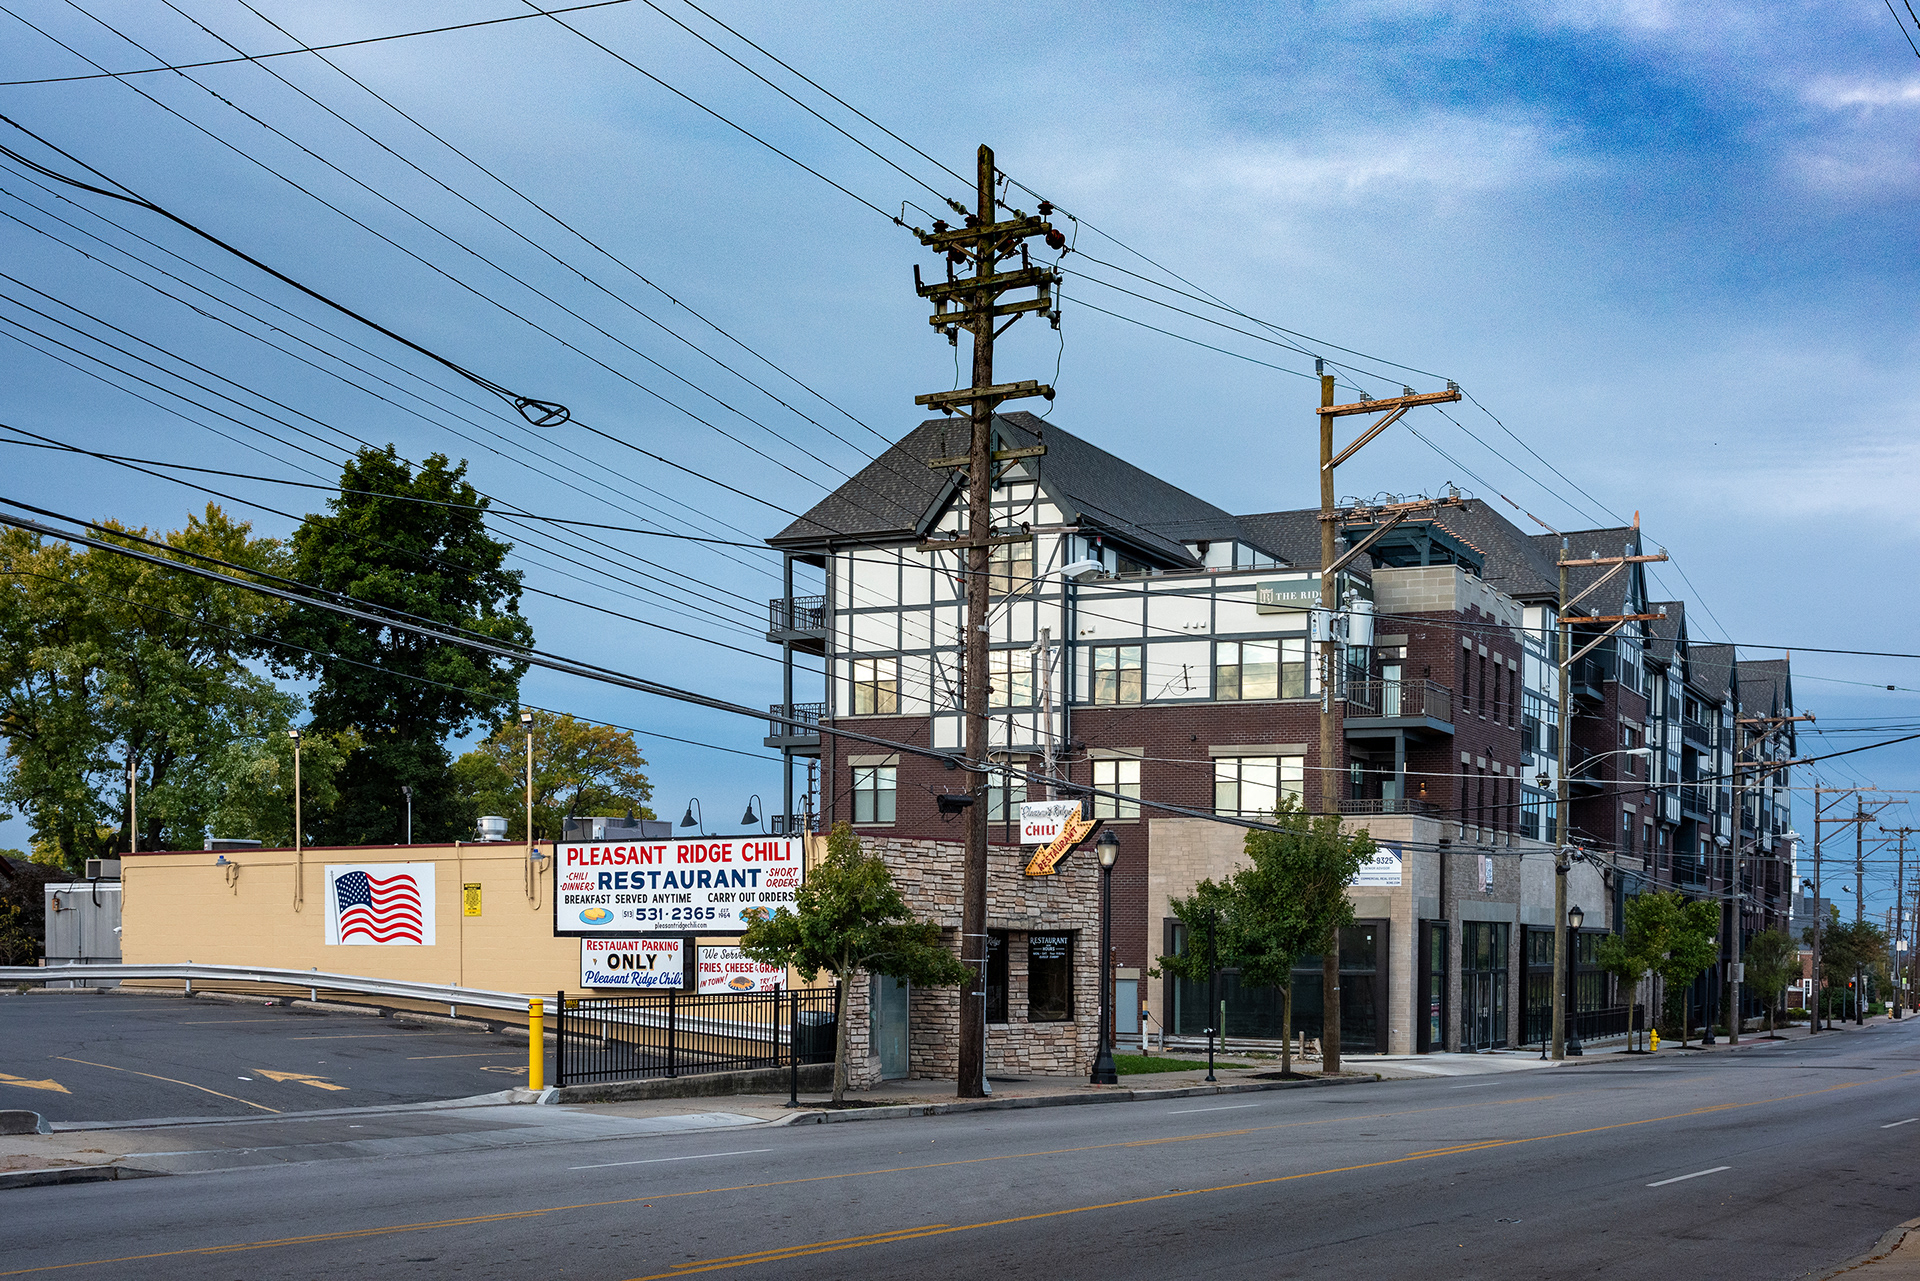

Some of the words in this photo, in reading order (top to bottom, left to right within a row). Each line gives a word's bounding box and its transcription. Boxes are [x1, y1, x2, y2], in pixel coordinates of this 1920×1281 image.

[1275, 592, 1297, 600] THE
[1300, 590, 1322, 599] RID
[1053, 805, 1072, 820] Ridge
[1025, 825, 1055, 836] CHILI
[567, 846, 667, 866] PLEASANT
[677, 843, 732, 863] RIDGE
[741, 842, 791, 862] CHILI
[1037, 826, 1078, 871] RESTAURANT
[598, 869, 761, 890] RESTAURANT
[766, 878, 799, 888] ORDERS
[561, 882, 595, 891] DINNERS
[564, 894, 611, 904] BREAKFAST
[615, 893, 648, 904] SERVED
[652, 893, 692, 903] ANYTIME
[707, 892, 736, 903] CARRY
[739, 892, 755, 902] OUT
[758, 892, 794, 902] ORDERS
[654, 921, 708, 930] pleasantridgechili.com
[641, 940, 679, 951] PARKING
[1030, 937, 1068, 945] RESTAURANT
[702, 948, 719, 960] We
[607, 953, 657, 971] ONLY
[699, 963, 724, 973] FRIES,
[725, 962, 754, 973] CHEESE
[759, 962, 785, 973] GRA
[585, 970, 630, 984] Pleasant
[631, 971, 658, 987] Ridge
[659, 971, 683, 985] Chili
[700, 980, 707, 988] IN
[708, 973, 729, 986] TOWN!
